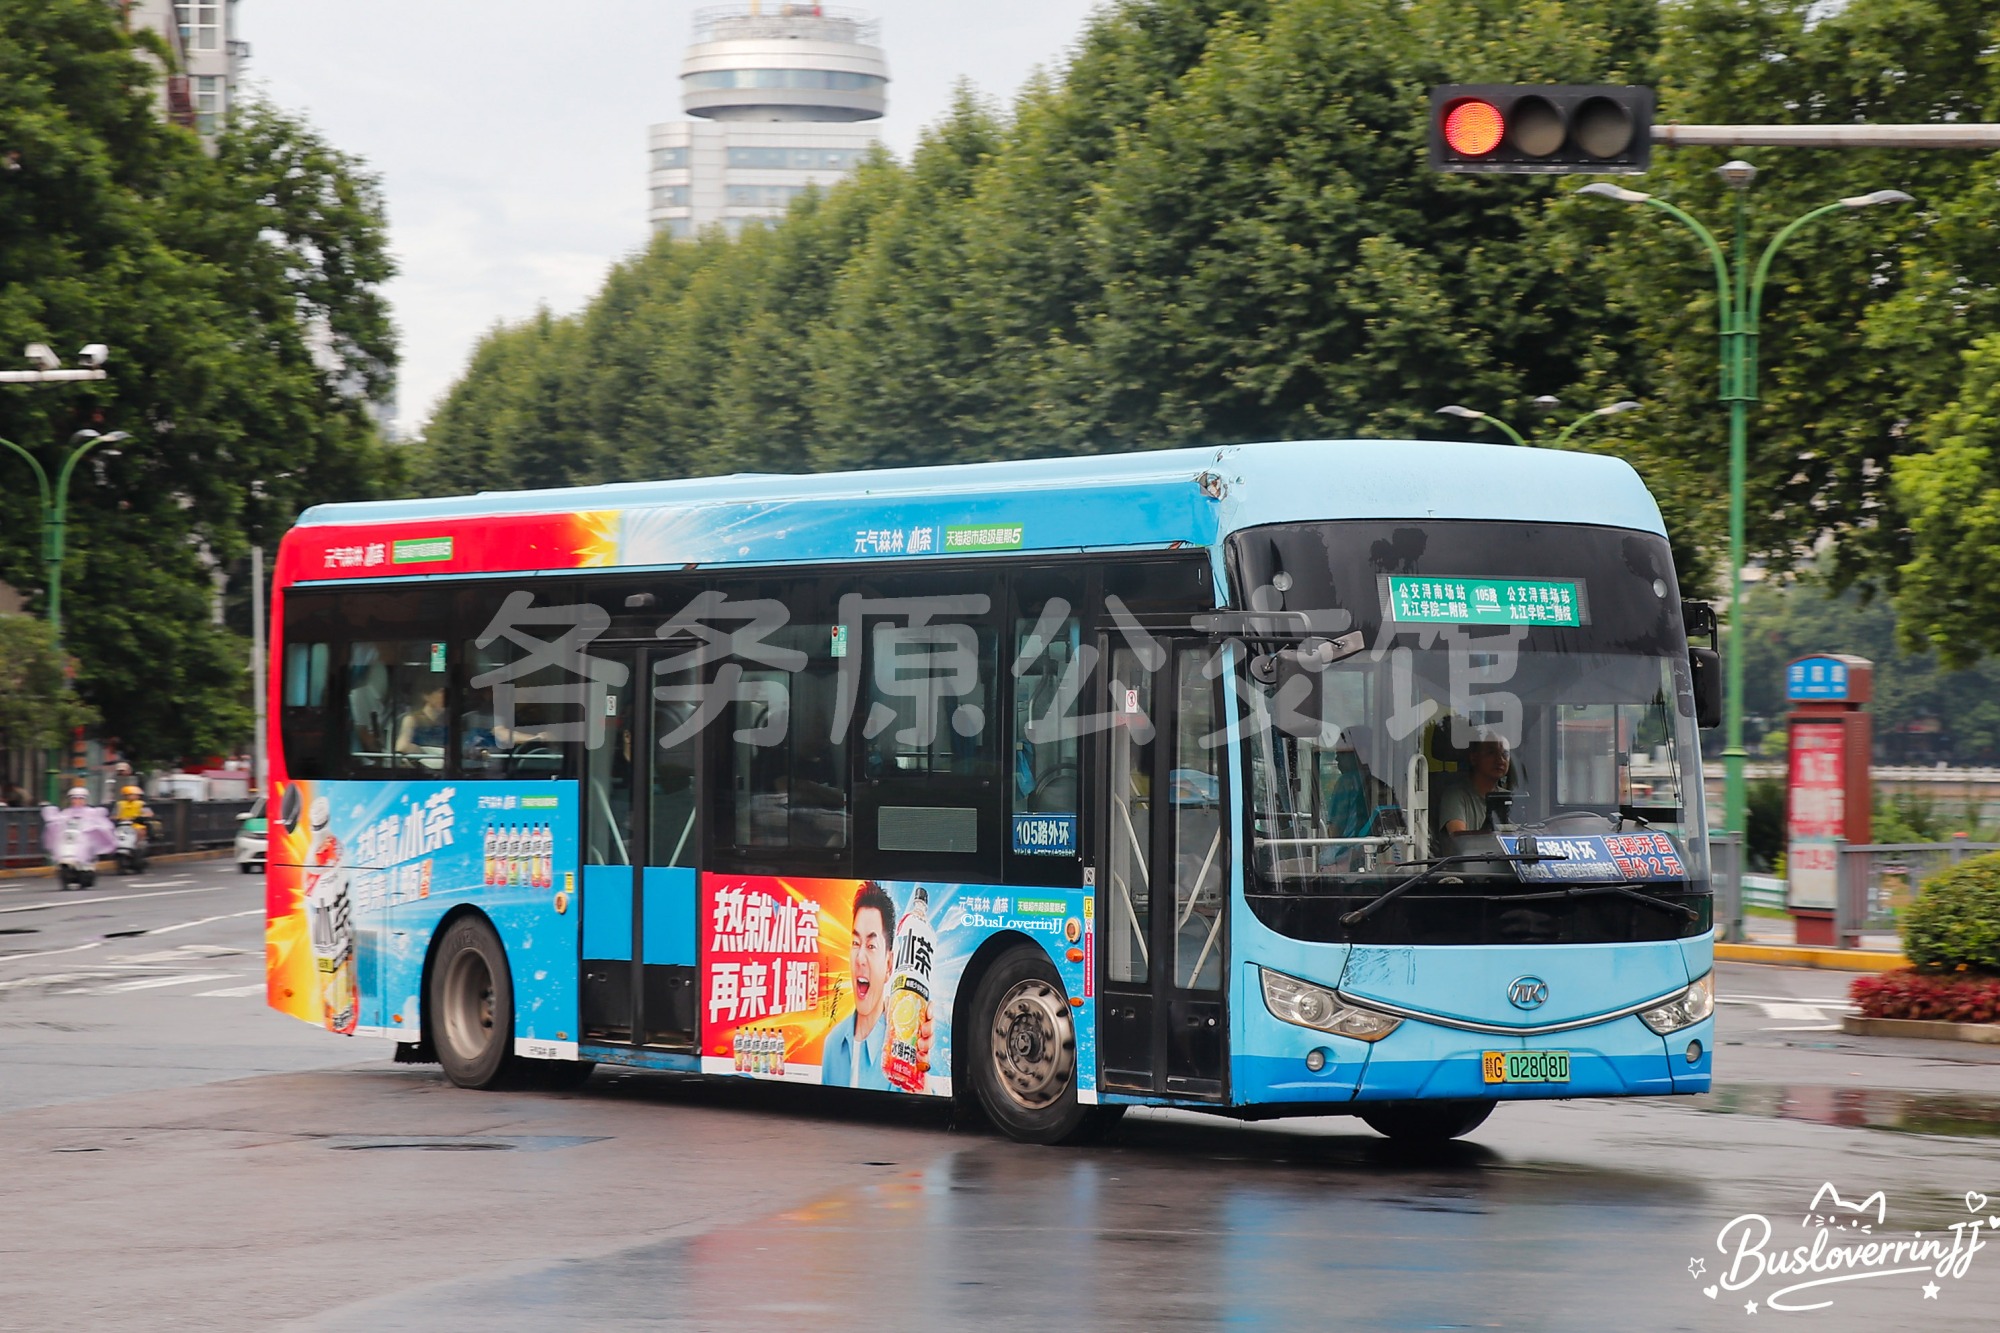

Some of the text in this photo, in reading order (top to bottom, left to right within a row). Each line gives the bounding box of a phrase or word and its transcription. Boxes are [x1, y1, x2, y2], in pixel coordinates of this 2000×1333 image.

[855, 526, 1022, 554] 元气森林 冰茶 天猫超市超级星期5
[1399, 582, 1466, 600] 公交浔南场站
[1475, 587, 1497, 602] 105路
[1507, 586, 1571, 604] 公交浔南场站
[1401, 600, 1468, 618] 九江学院二附院
[1510, 603, 1572, 621] 九江学院二附院
[1016, 820, 1069, 846] 105路外环
[1605, 834, 1674, 857] 空调开启
[1617, 856, 1684, 879] 票价2元
[958, 896, 991, 914] 元气森林
[710, 882, 820, 954] 热就冰茶
[895, 928, 934, 981] 冰茶
[709, 957, 808, 1023] 再来1瓶
[1510, 1056, 1567, 1078] 02808D
